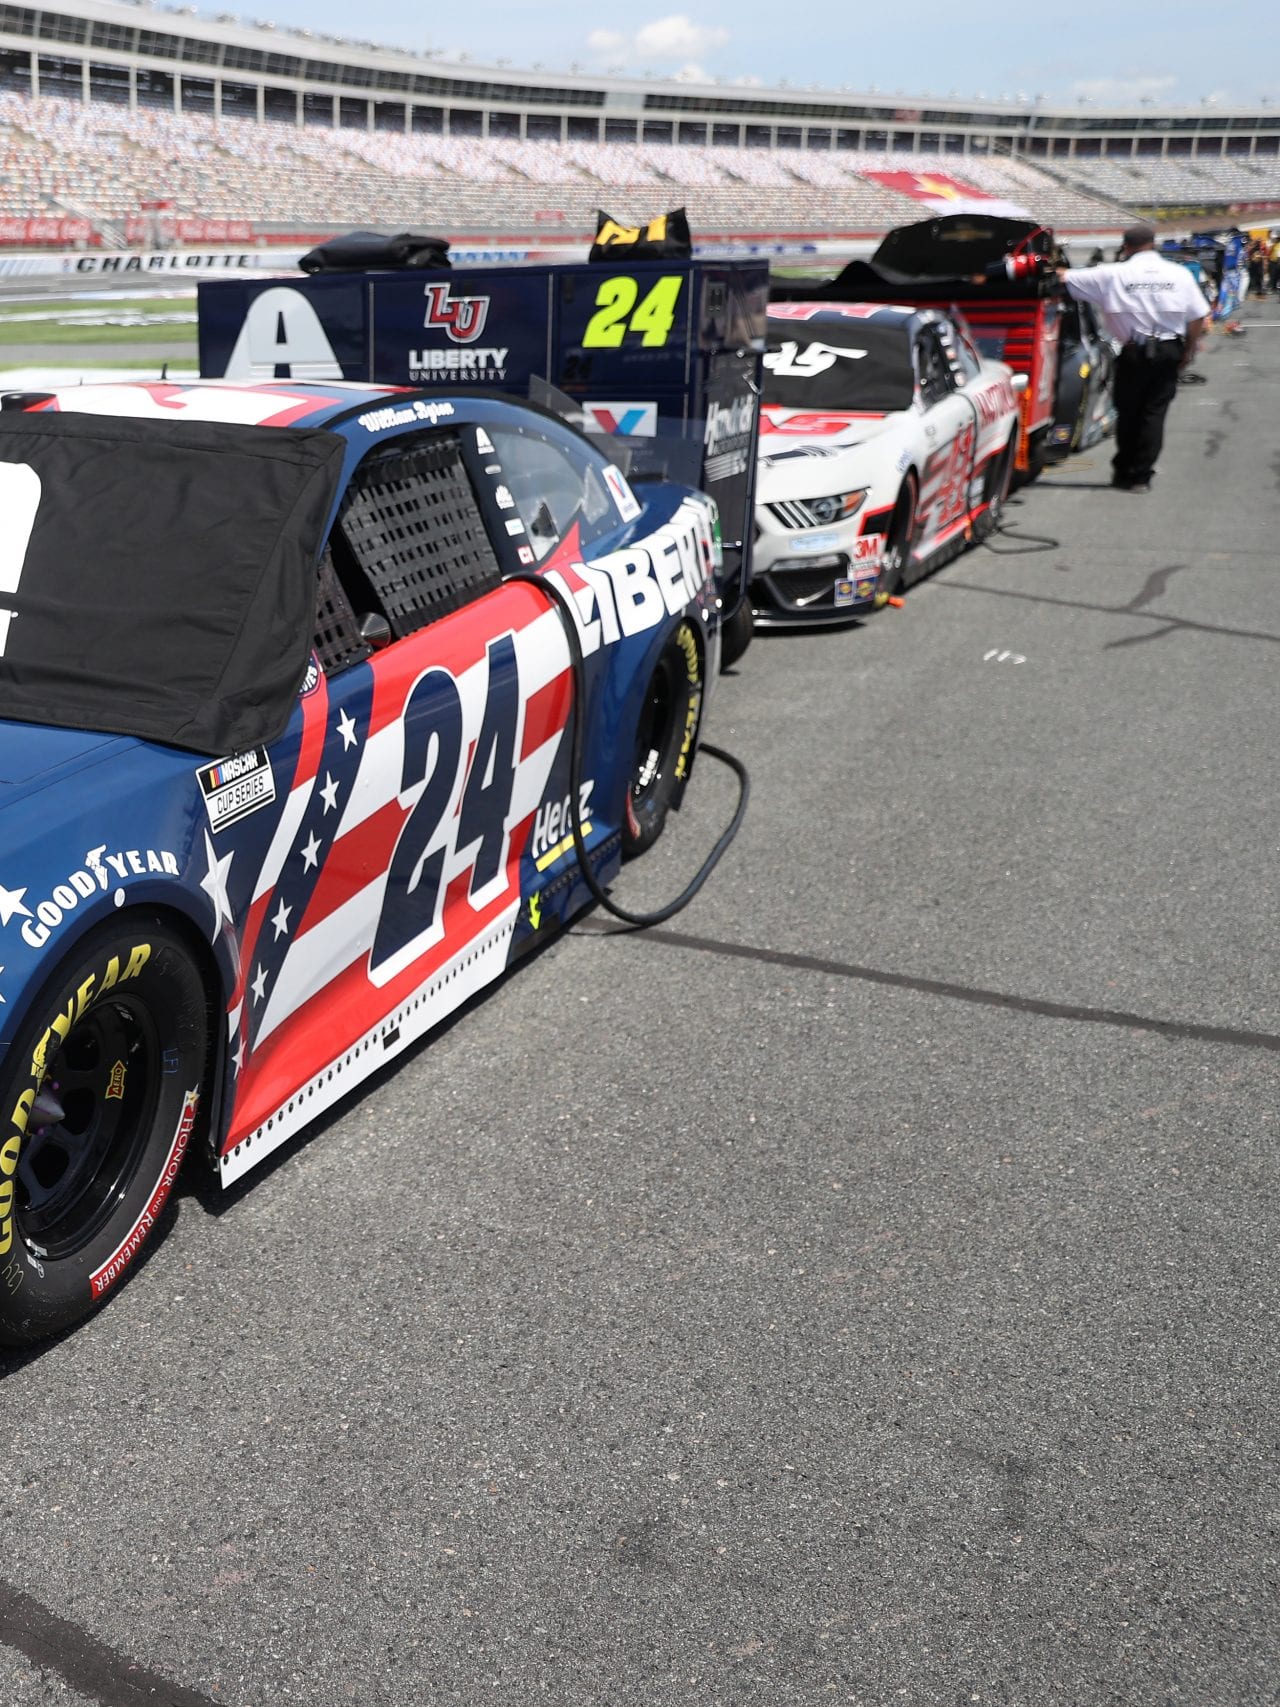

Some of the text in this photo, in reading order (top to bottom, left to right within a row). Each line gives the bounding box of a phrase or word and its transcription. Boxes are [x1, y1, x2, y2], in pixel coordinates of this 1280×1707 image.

[77, 254, 249, 274] CHARLOTTE
[582, 276, 683, 348] 24
[409, 348, 509, 370] LIBERTY
[409, 369, 507, 381] UNIVERSITY
[854, 539, 878, 559] 3M
[222, 750, 259, 783] NASCAR
[217, 775, 265, 814] CUP SERIES
[367, 629, 520, 987] 24
[531, 779, 595, 859] Herz
[112, 1066, 123, 1094] AERO
[95, 1116, 194, 1293] HONOR AND REMEMBER
